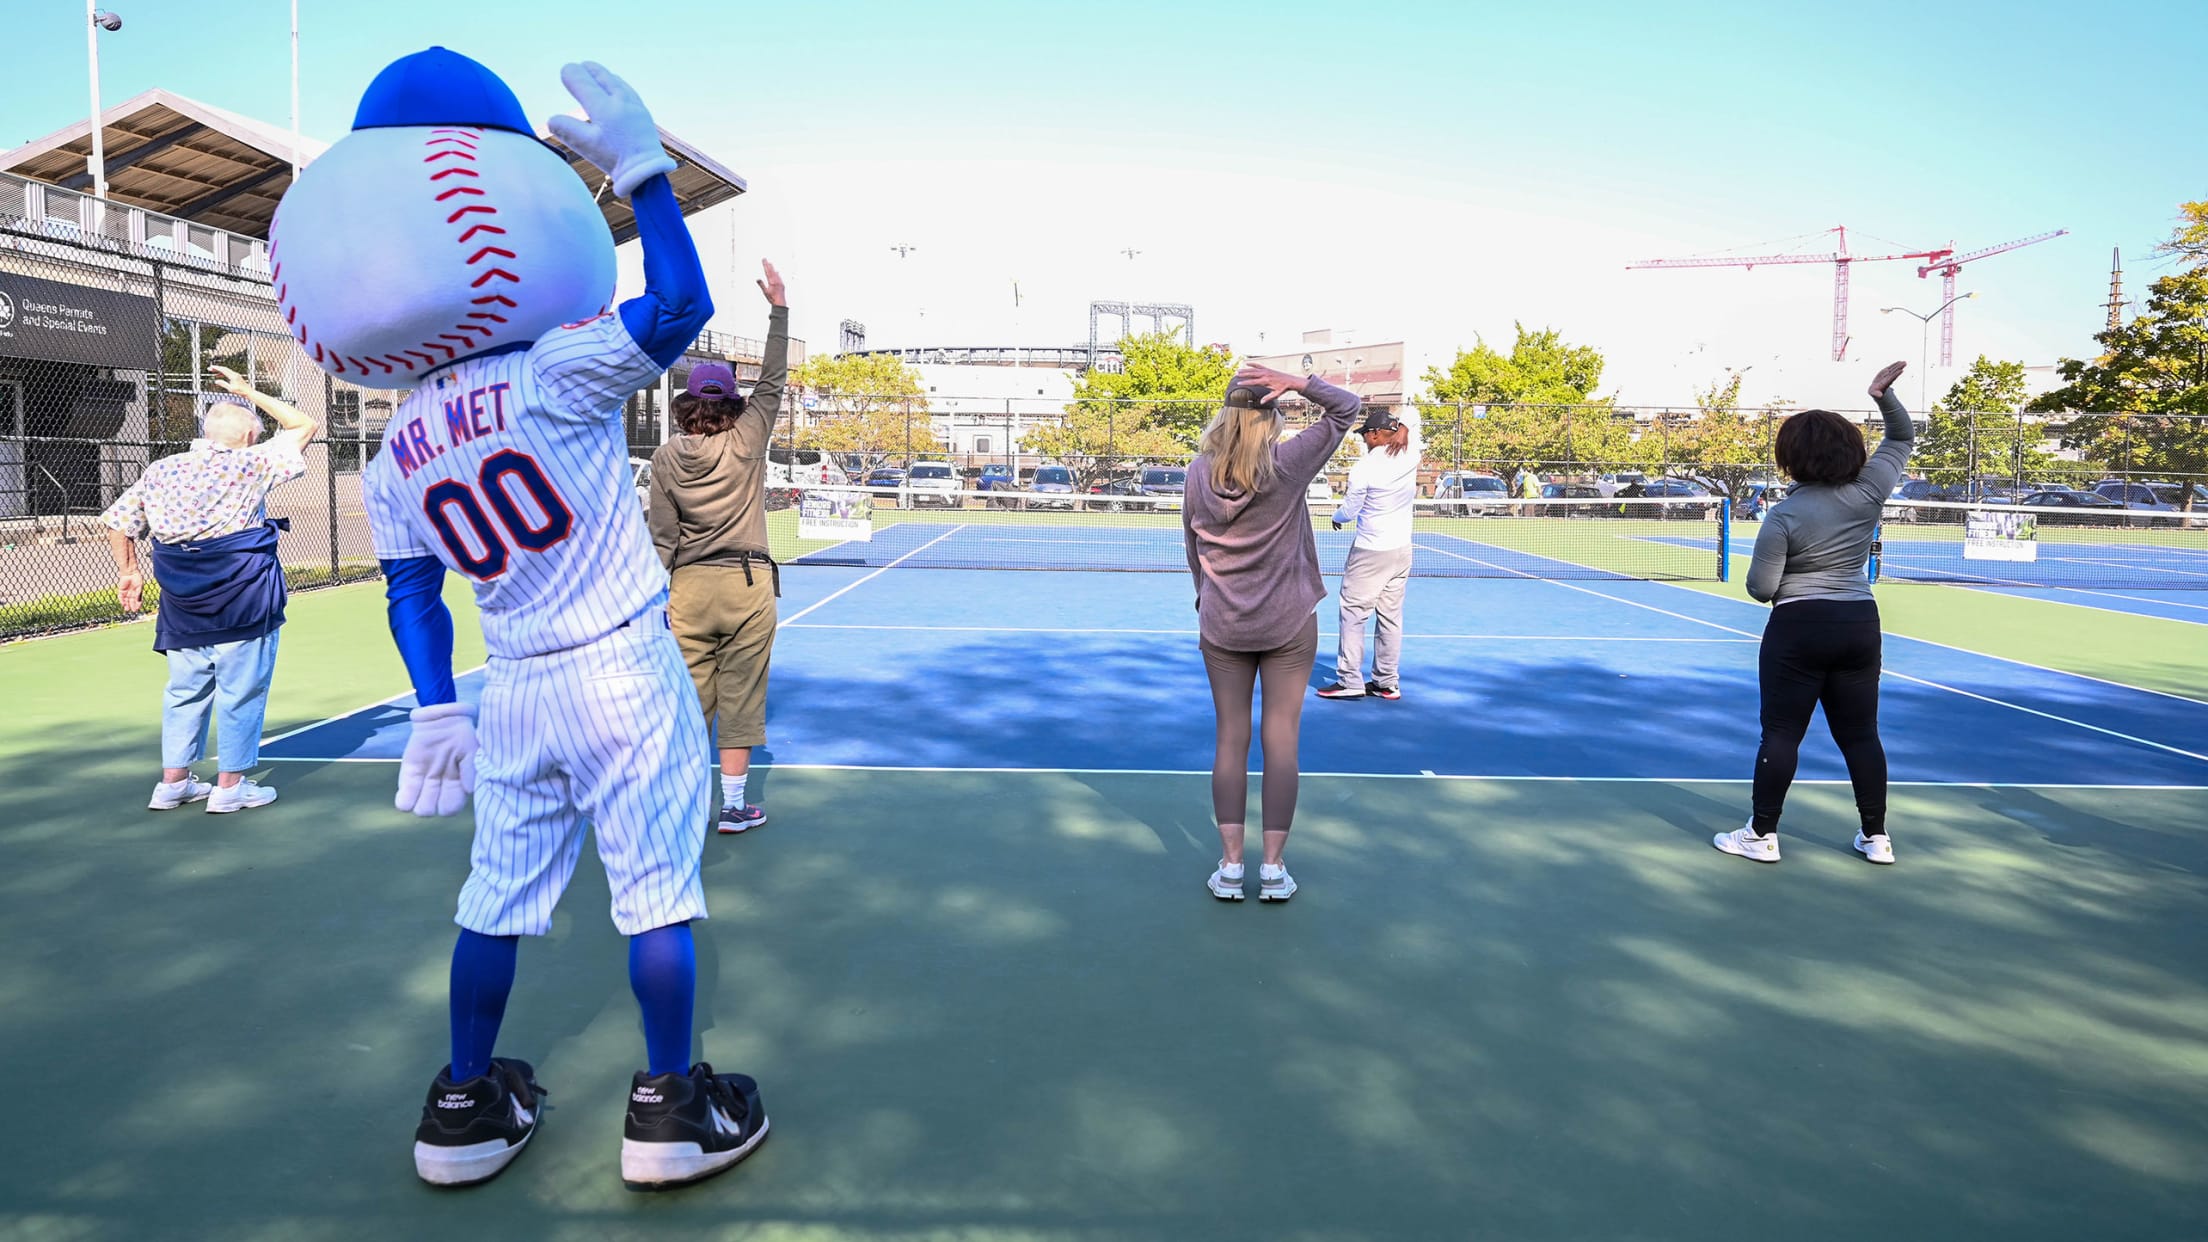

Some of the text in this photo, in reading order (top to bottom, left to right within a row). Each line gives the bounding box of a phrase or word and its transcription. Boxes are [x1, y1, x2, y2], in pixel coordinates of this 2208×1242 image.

[22, 298, 94, 320] Queens Permits
[22, 315, 107, 335] and Special Events
[390, 381, 511, 480] MR. MET
[423, 448, 574, 582] 00
[437, 1099, 475, 1109] balance
[445, 1093, 467, 1101] new
[632, 1092, 664, 1103] balance
